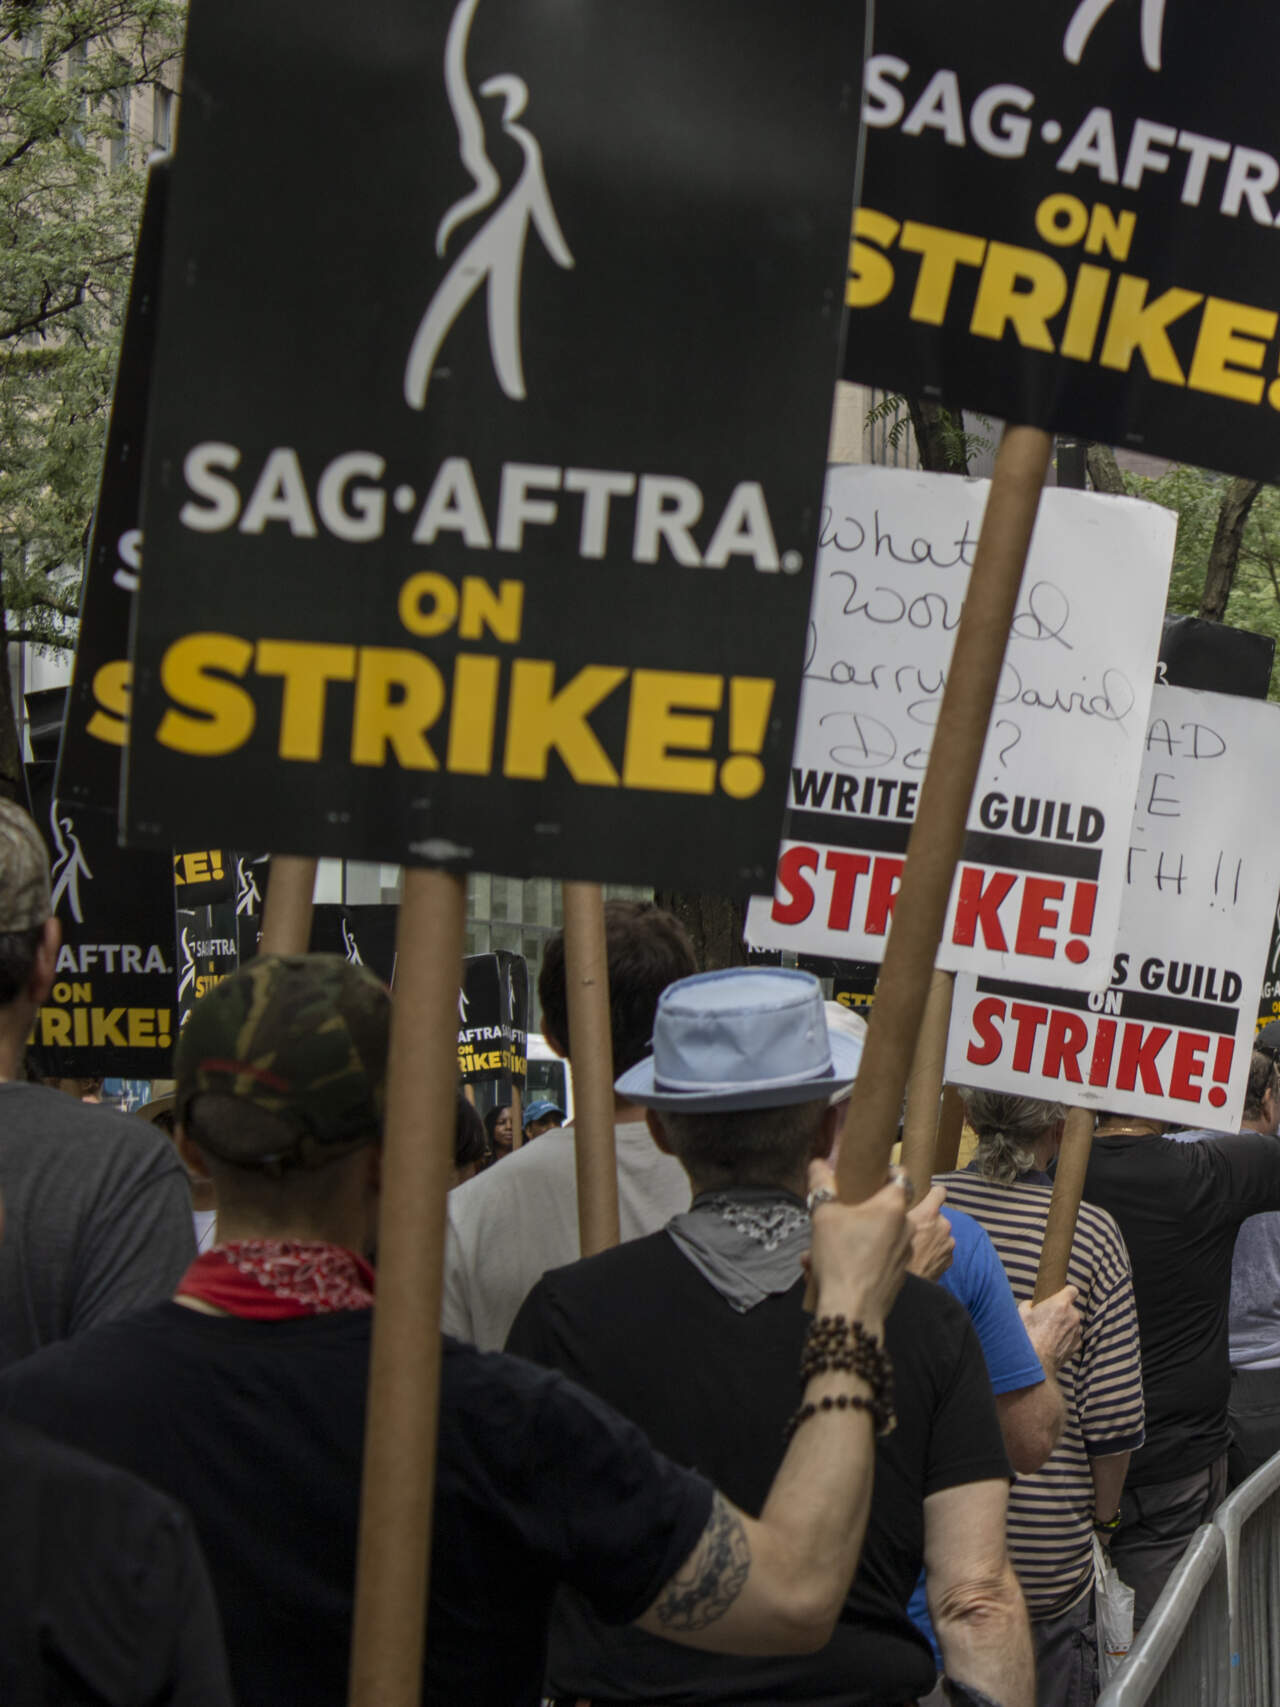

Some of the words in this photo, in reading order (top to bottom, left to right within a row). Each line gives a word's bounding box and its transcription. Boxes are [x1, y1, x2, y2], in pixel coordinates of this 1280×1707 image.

[1035, 192, 1136, 261] ON
[400, 572, 523, 644] ON
[830, 571, 1073, 650] Woud
[157, 633, 775, 799] STRIKE!
[791, 767, 919, 820] WRITE
[979, 791, 1105, 843] GUILD
[770, 845, 1098, 965] STRKE!
[53, 982, 92, 1004] ON
[1087, 990, 1123, 1015] ON
[1140, 957, 1243, 1003] GUILD
[26, 1006, 172, 1048] RIKE!
[966, 997, 1236, 1108] STRIKE!
